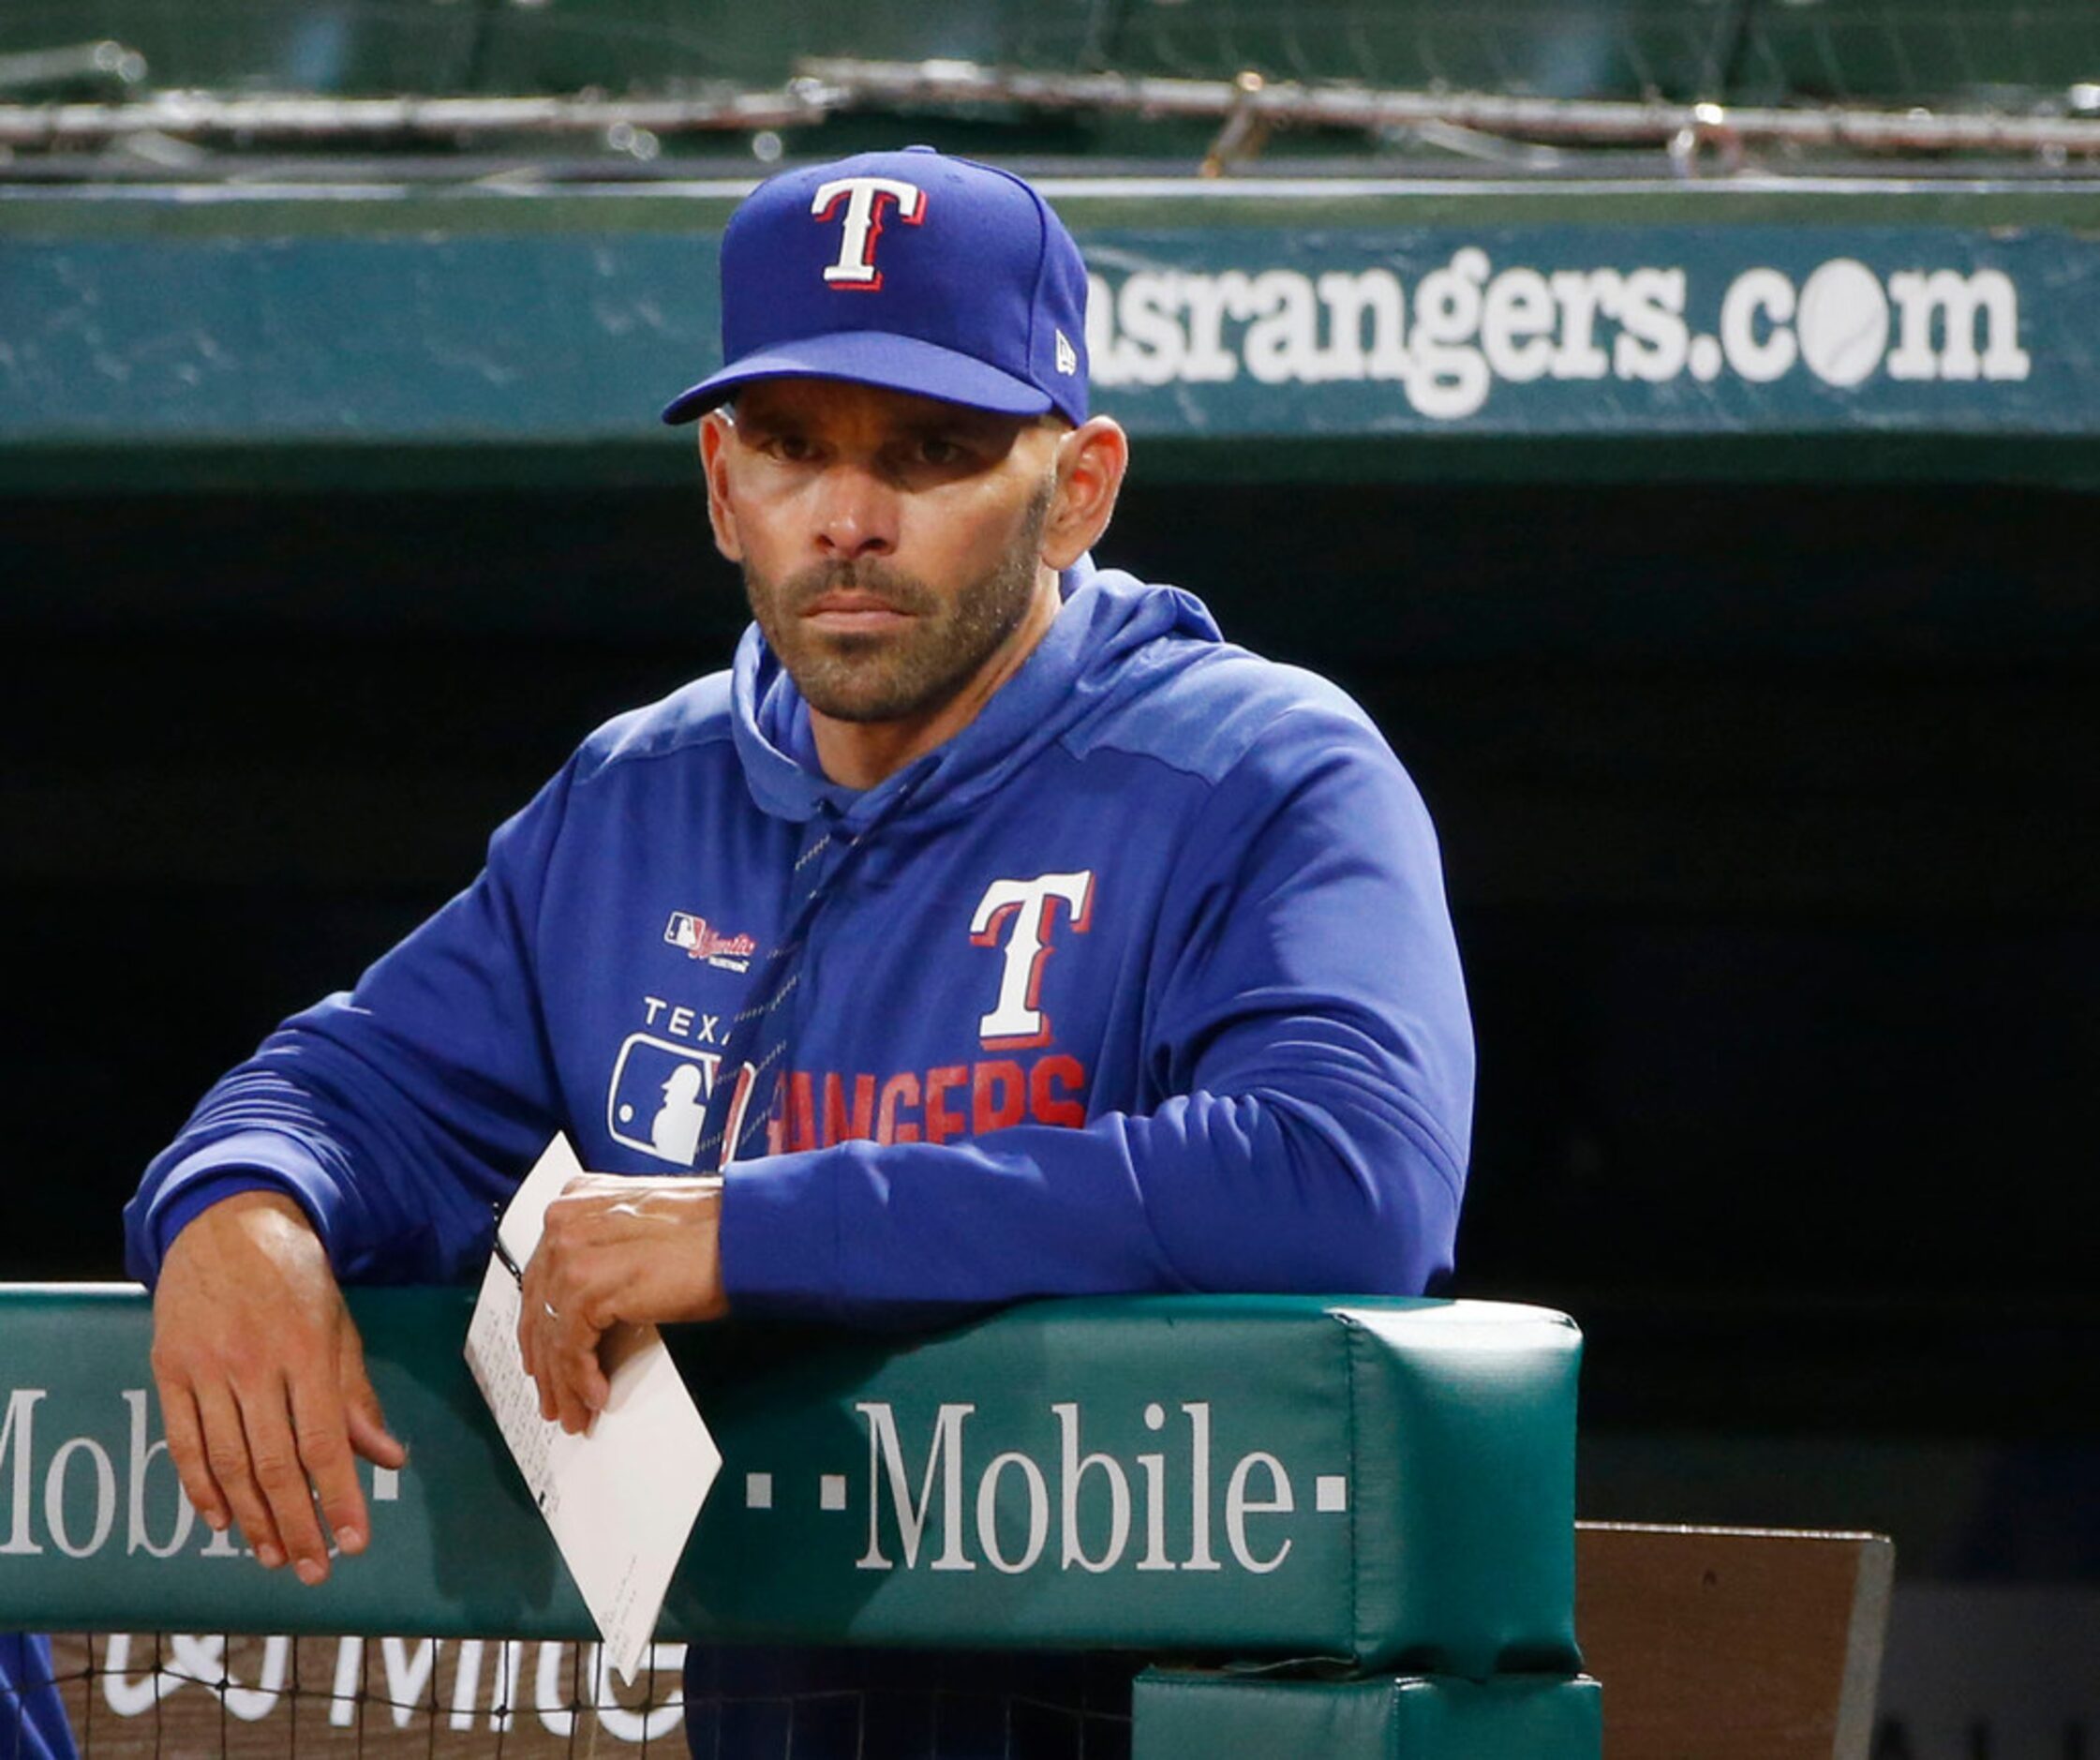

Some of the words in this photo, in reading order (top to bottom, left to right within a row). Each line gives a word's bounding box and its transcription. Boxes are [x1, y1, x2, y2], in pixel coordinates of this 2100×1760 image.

[812, 176, 928, 291] T
[970, 869, 1095, 1051] T
[856, 1402, 1295, 1574] Mobile
